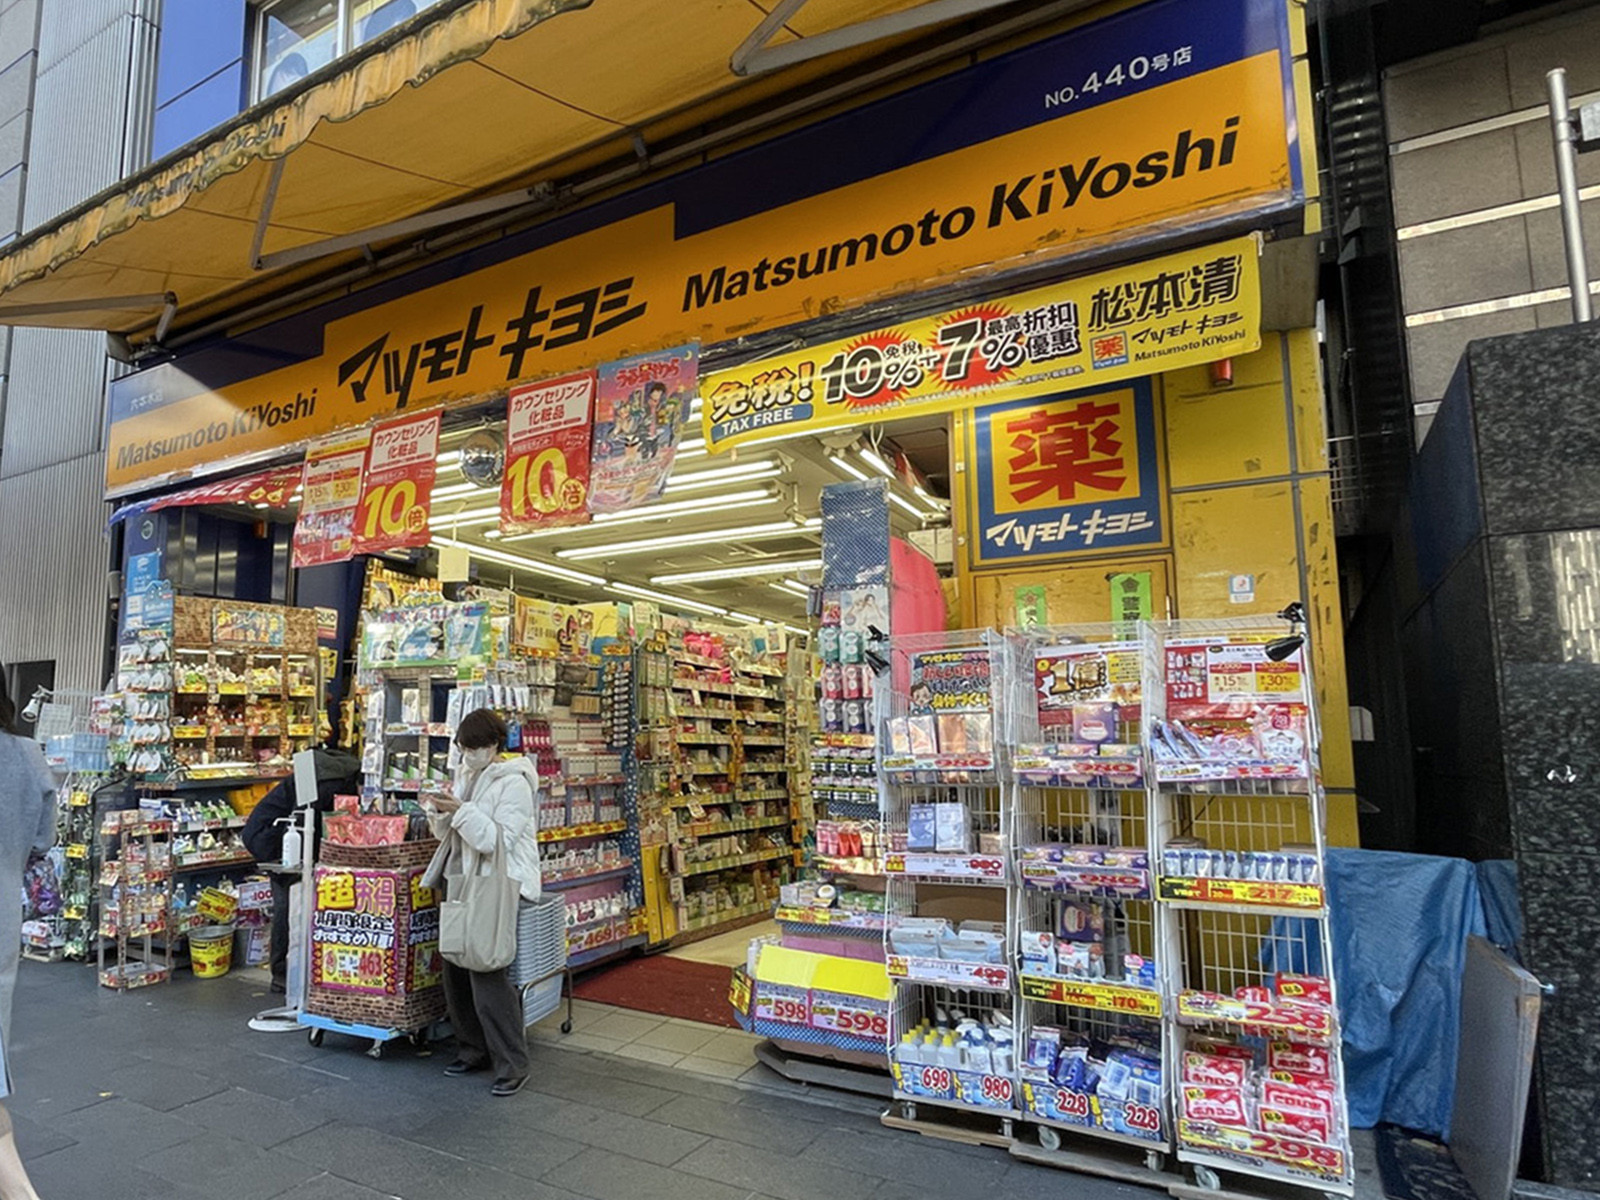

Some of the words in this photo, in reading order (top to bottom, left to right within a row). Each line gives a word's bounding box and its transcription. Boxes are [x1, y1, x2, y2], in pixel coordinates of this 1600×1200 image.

[1045, 87, 1080, 108] NO.
[682, 206, 975, 313] Matsumoto
[988, 116, 1240, 228] KiYoshi
[1088, 254, 1242, 331] 松本清
[338, 276, 647, 409] マツモトキヨシ
[1132, 312, 1243, 344] マツモトキヨシ
[1135, 339, 1200, 362] Matsumoto
[1201, 329, 1246, 348] KiYoshi
[513, 381, 590, 413] カウンセリング
[116, 421, 228, 470] Matsumoto
[231, 388, 318, 437] KiYoshi
[529, 404, 565, 426] 化粧品
[721, 416, 749, 437] TAX
[752, 407, 794, 427] FREE
[375, 418, 437, 448] カウンセリング
[387, 440, 419, 460] 化粧品
[1007, 401, 1127, 504] 薬
[507, 447, 568, 517] 10
[364, 479, 417, 538] 10
[986, 509, 1154, 551] マツモトキヨシ
[774, 1001, 807, 1021] 598
[837, 1010, 888, 1035] 598
[1246, 1005, 1327, 1029] 258
[922, 1067, 950, 1090] 698
[983, 1076, 1011, 1100] 980
[1057, 1090, 1089, 1117] 228
[1126, 1104, 1159, 1131] 228
[1251, 1135, 1340, 1167] 298
